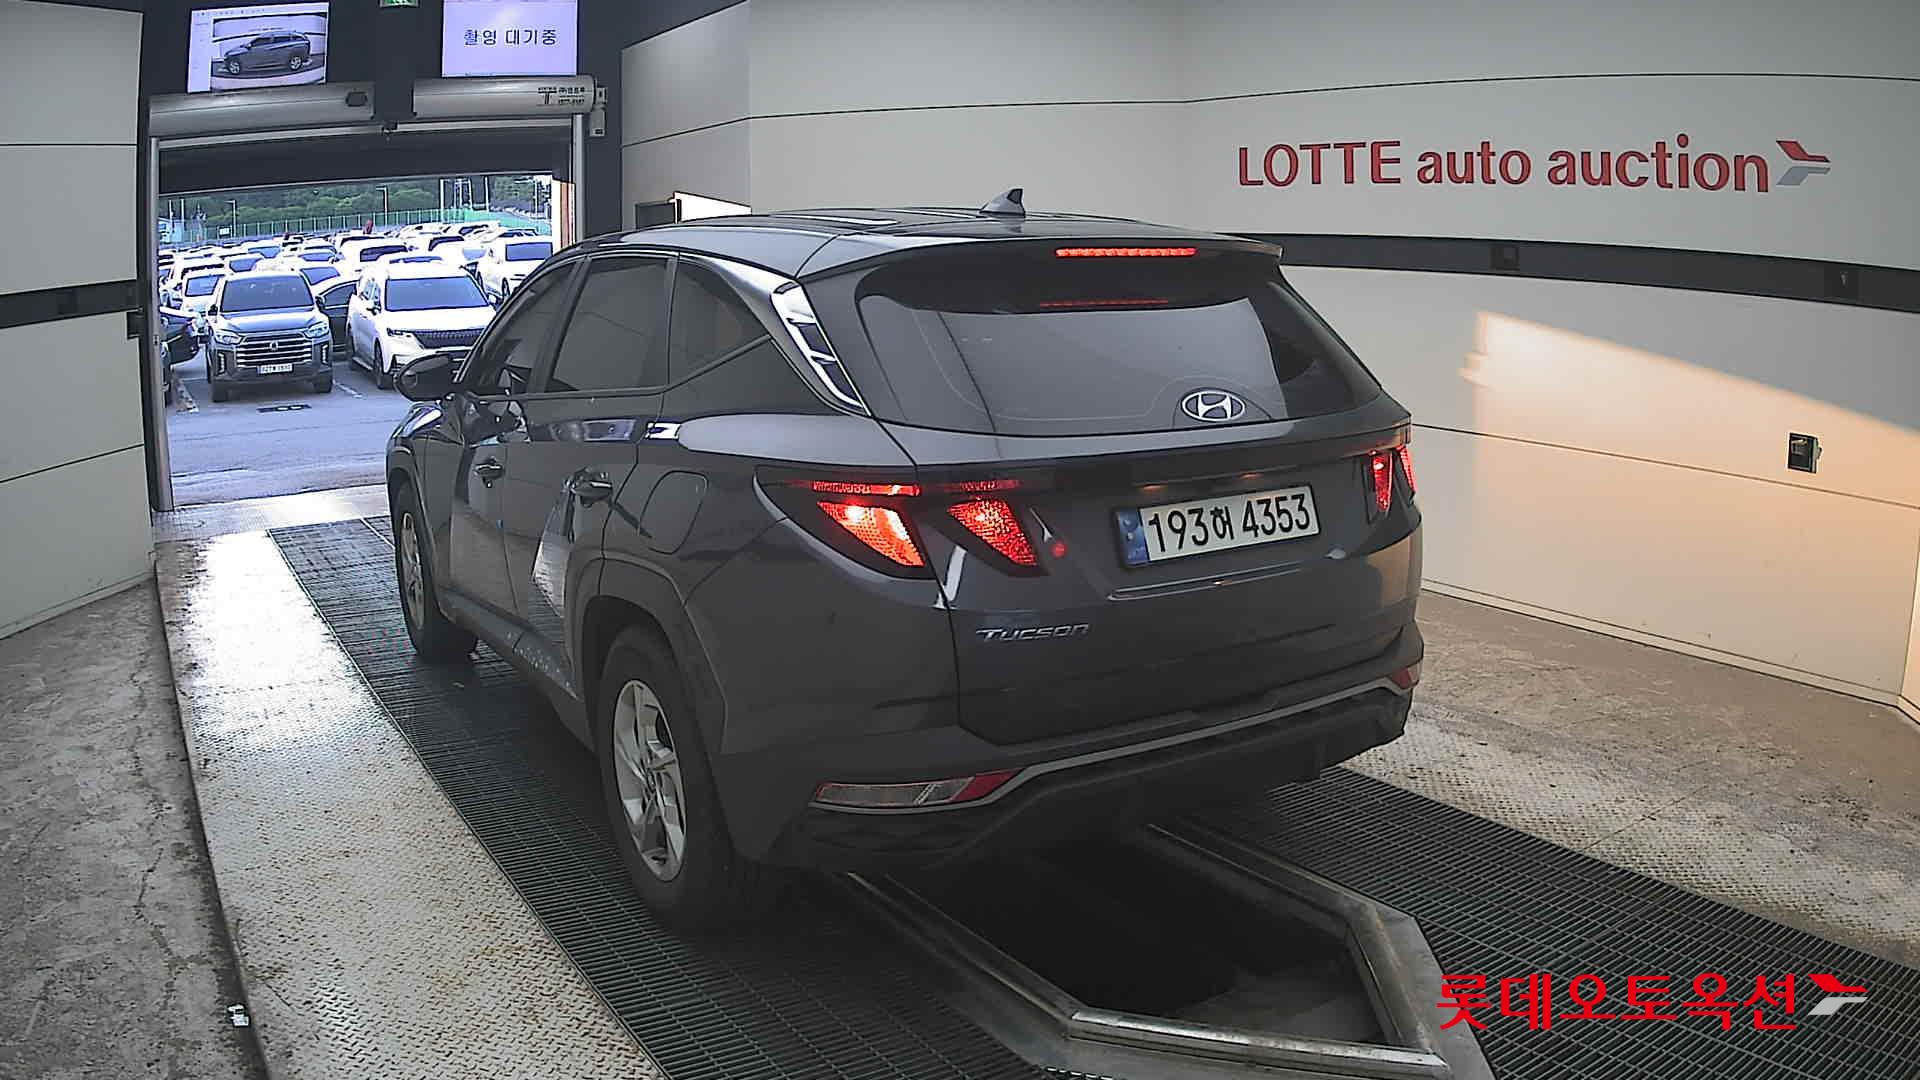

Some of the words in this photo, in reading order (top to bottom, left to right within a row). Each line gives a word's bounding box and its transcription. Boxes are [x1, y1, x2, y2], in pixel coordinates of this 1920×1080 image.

[505, 29, 557, 46] 대기중
[1238, 140, 1401, 187] LOTTE
[1416, 141, 1532, 185] auto
[1547, 133, 1769, 193] auction
[1148, 505, 1235, 553] 193허
[1241, 493, 1311, 538] 4353
